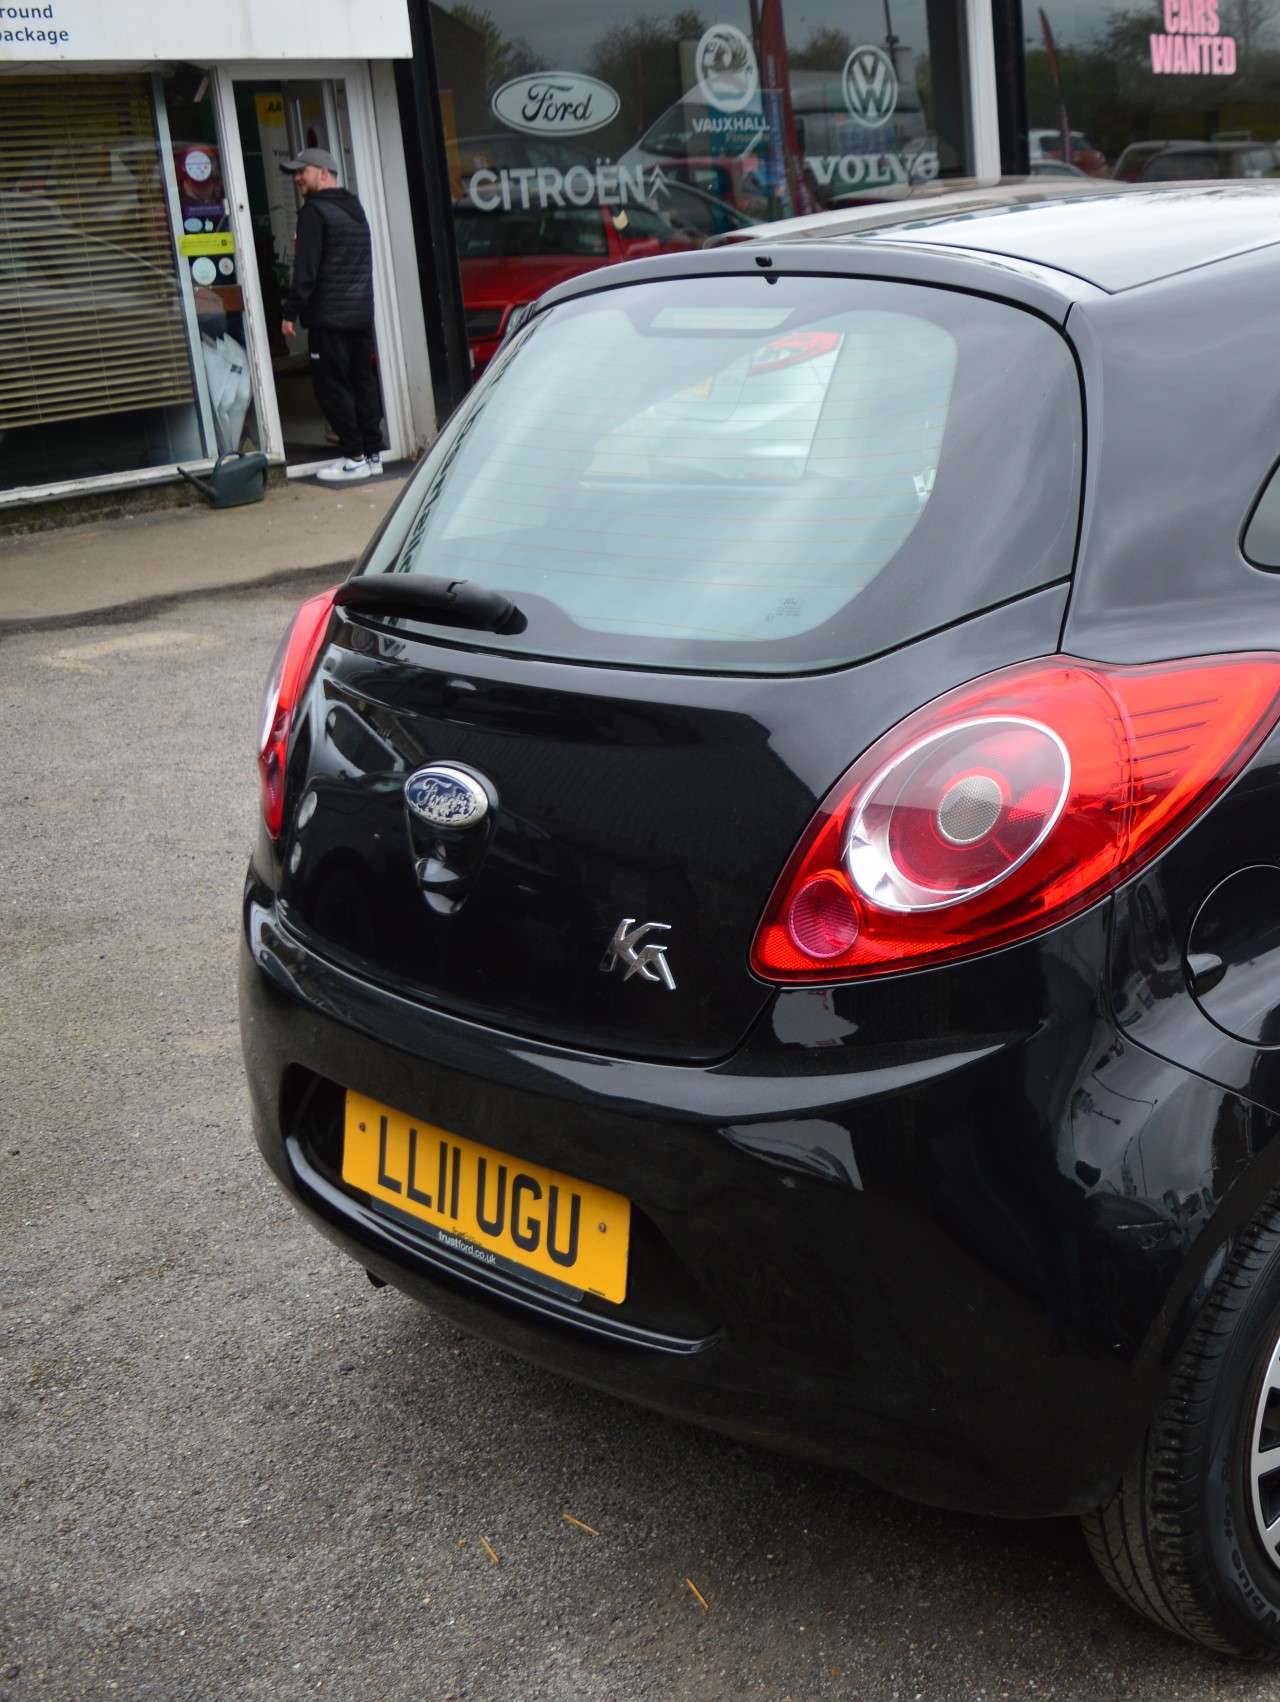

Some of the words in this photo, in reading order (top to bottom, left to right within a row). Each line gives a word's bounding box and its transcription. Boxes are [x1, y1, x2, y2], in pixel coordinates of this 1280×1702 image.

[0, 27, 70, 45] ackage
[1163, 0, 1219, 35] CARS
[1150, 33, 1237, 75] WANTED
[521, 83, 593, 122] Ford
[692, 117, 770, 134] VAUXHALL
[469, 157, 648, 212] CITROËN
[416, 777, 472, 816] Ford
[377, 1115, 462, 1220] LL11
[475, 1156, 582, 1268] UGU
[438, 1231, 497, 1265] trustford.co.uk
